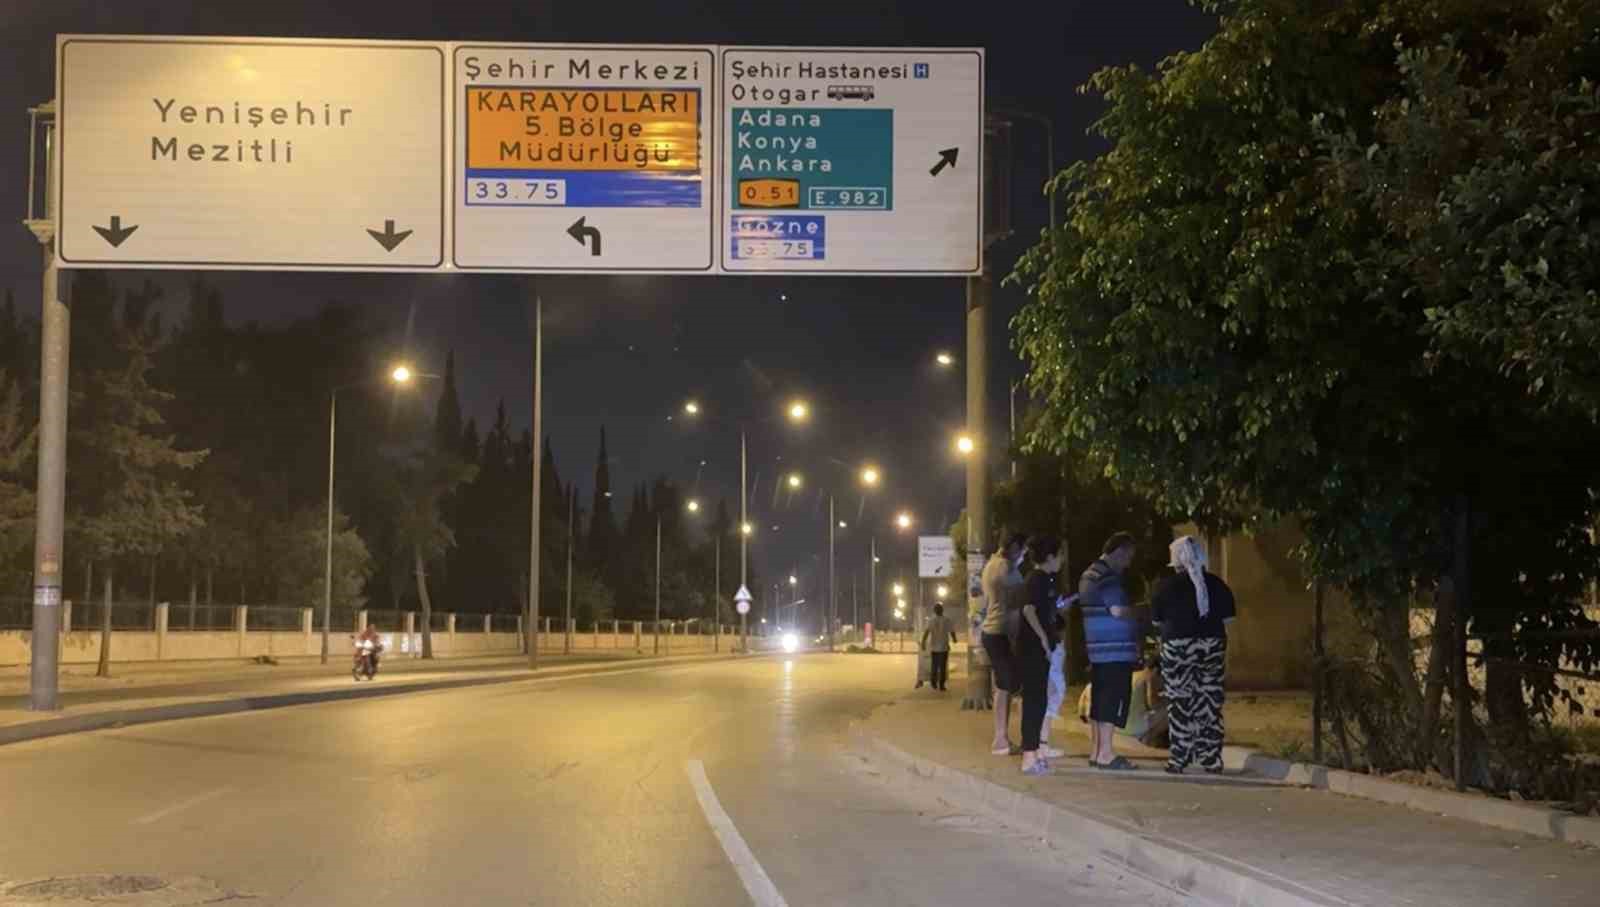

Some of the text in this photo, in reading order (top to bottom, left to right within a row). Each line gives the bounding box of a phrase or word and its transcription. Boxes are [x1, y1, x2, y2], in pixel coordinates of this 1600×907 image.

[465, 56, 699, 81] Şehir Merkezi
[731, 60, 927, 80] Şehir Hastanesi H
[477, 91, 688, 113] KARAYOLLARI
[731, 83, 820, 104] Otogar
[153, 98, 353, 128] Yenişehir
[739, 109, 821, 127] Adana
[559, 116, 643, 142] Bölge
[151, 136, 294, 163] Mezitli
[737, 131, 817, 154] Konya
[499, 141, 670, 168] Müdürlüğü
[738, 154, 832, 172] Ankara
[475, 182, 558, 199] 33.75
[815, 191, 879, 205] E.982
